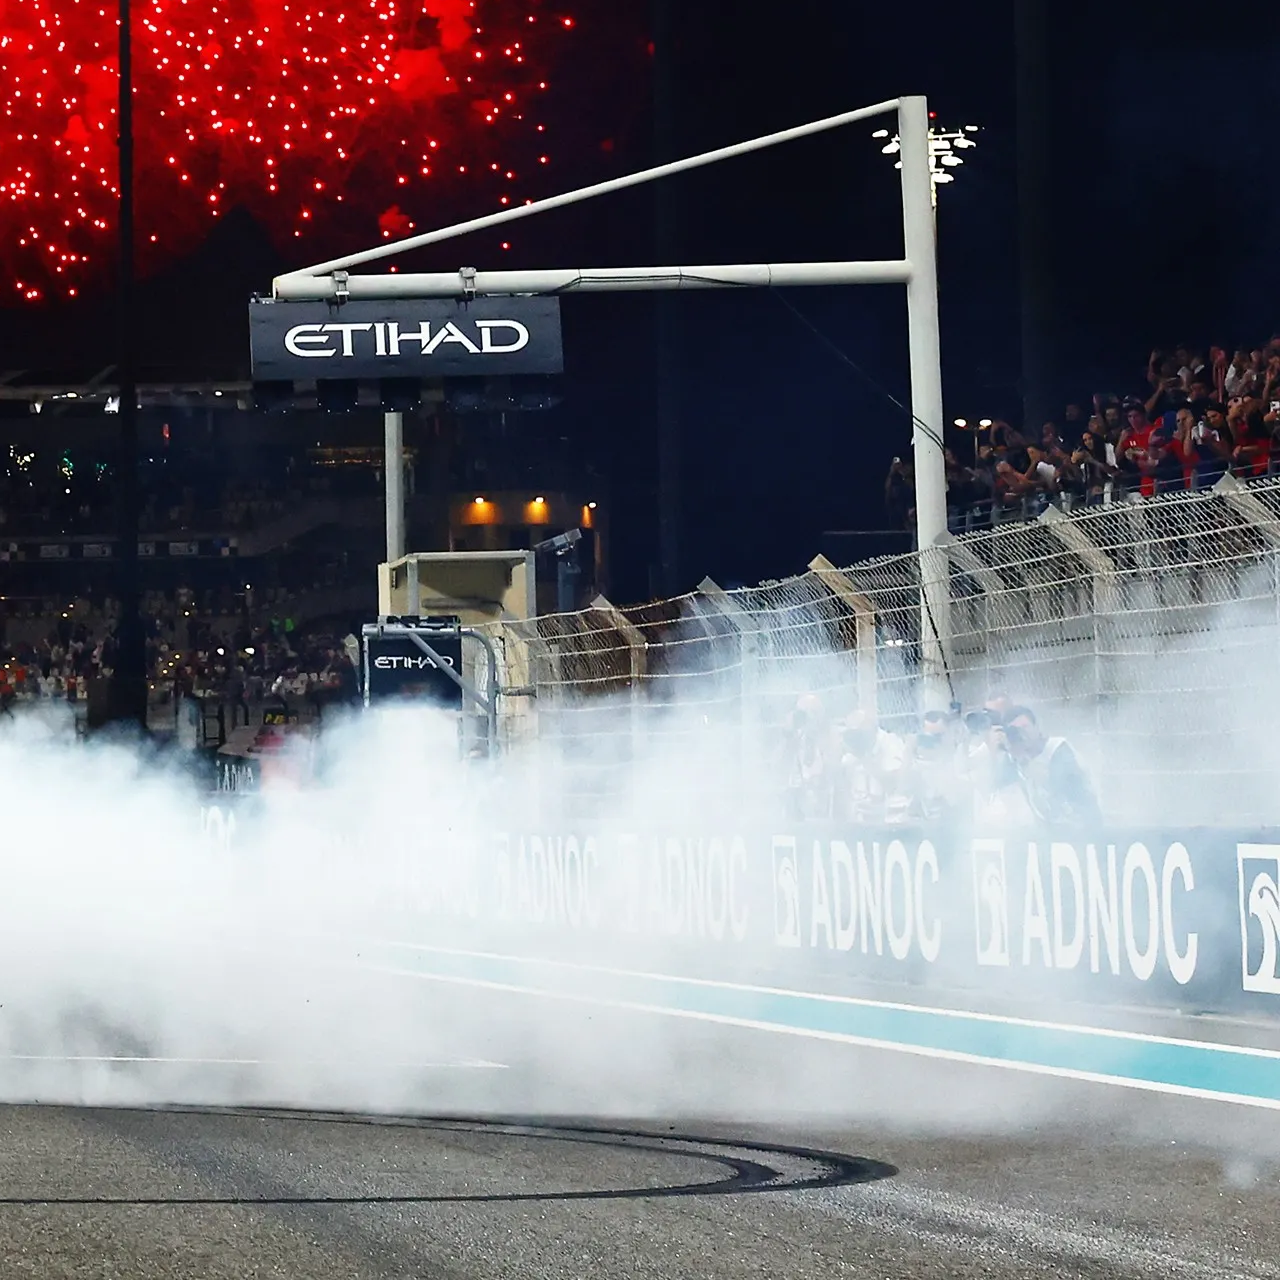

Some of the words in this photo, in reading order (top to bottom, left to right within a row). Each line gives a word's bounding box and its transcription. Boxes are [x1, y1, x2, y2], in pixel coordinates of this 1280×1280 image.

[285, 320, 529, 357] ETIHAD
[809, 838, 940, 963] ADNOC
[1022, 841, 1198, 985] ADNOC
